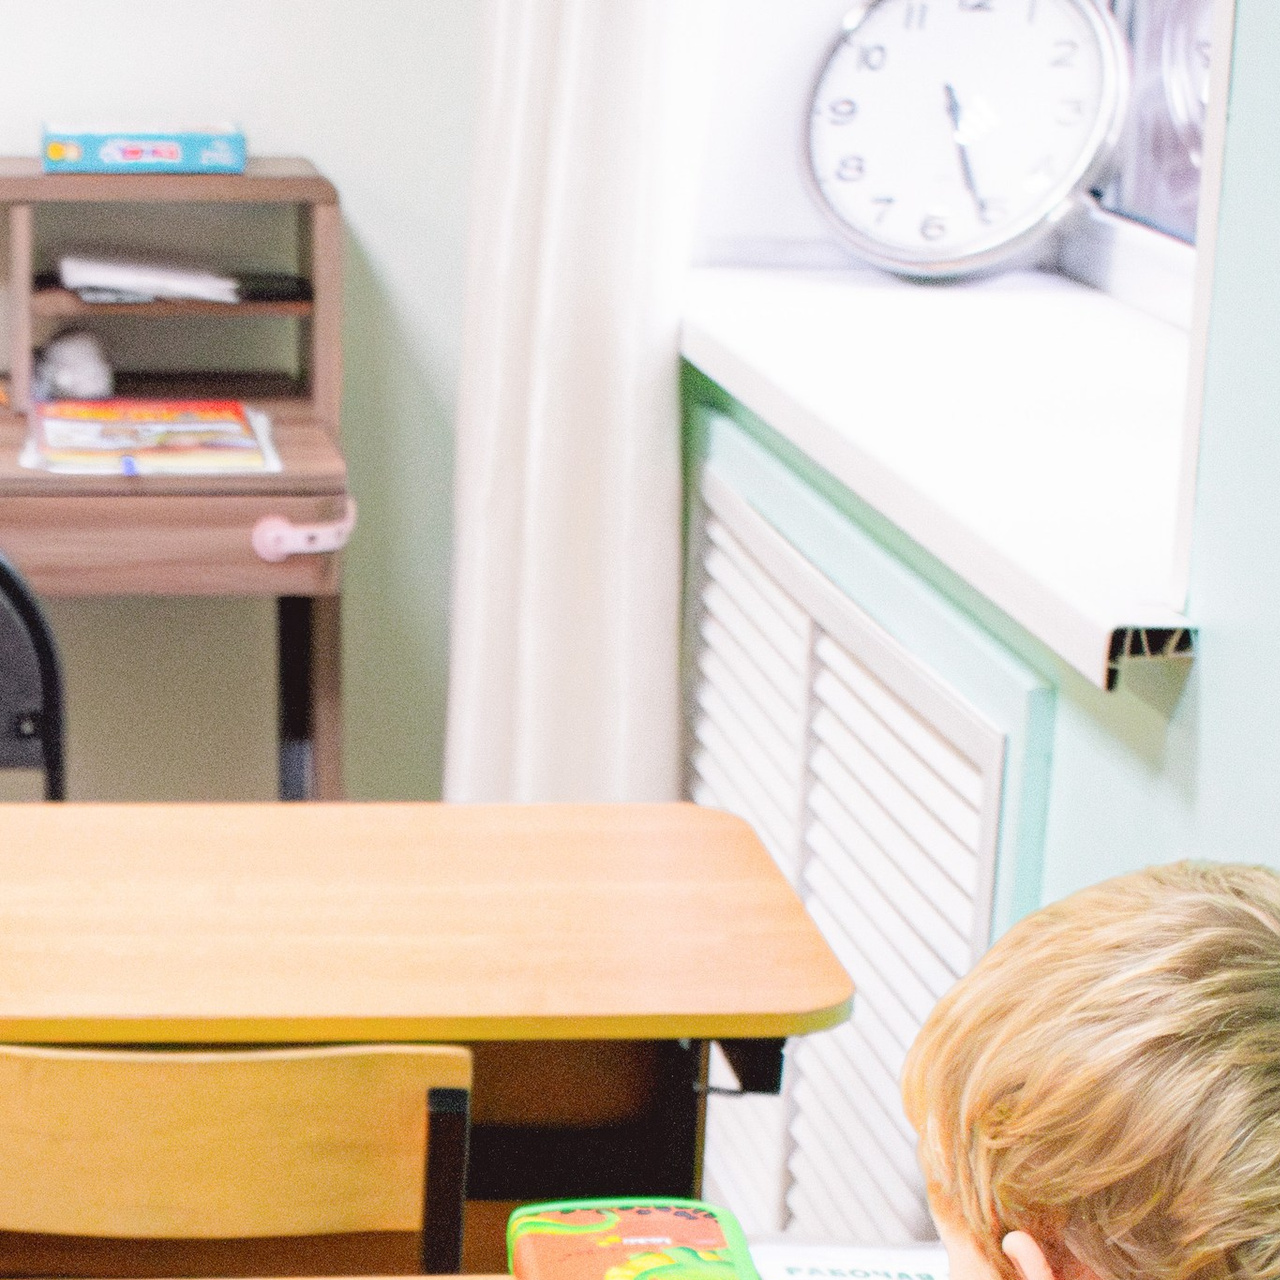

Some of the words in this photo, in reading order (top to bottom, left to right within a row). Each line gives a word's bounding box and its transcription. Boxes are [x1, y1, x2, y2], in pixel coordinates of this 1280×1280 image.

[856, 43, 888, 71] 10
[1049, 39, 1079, 67] 2
[829, 98, 858, 126] 9
[834, 154, 866, 183] 8
[869, 196, 896, 226] 7
[919, 214, 947, 242] 6
